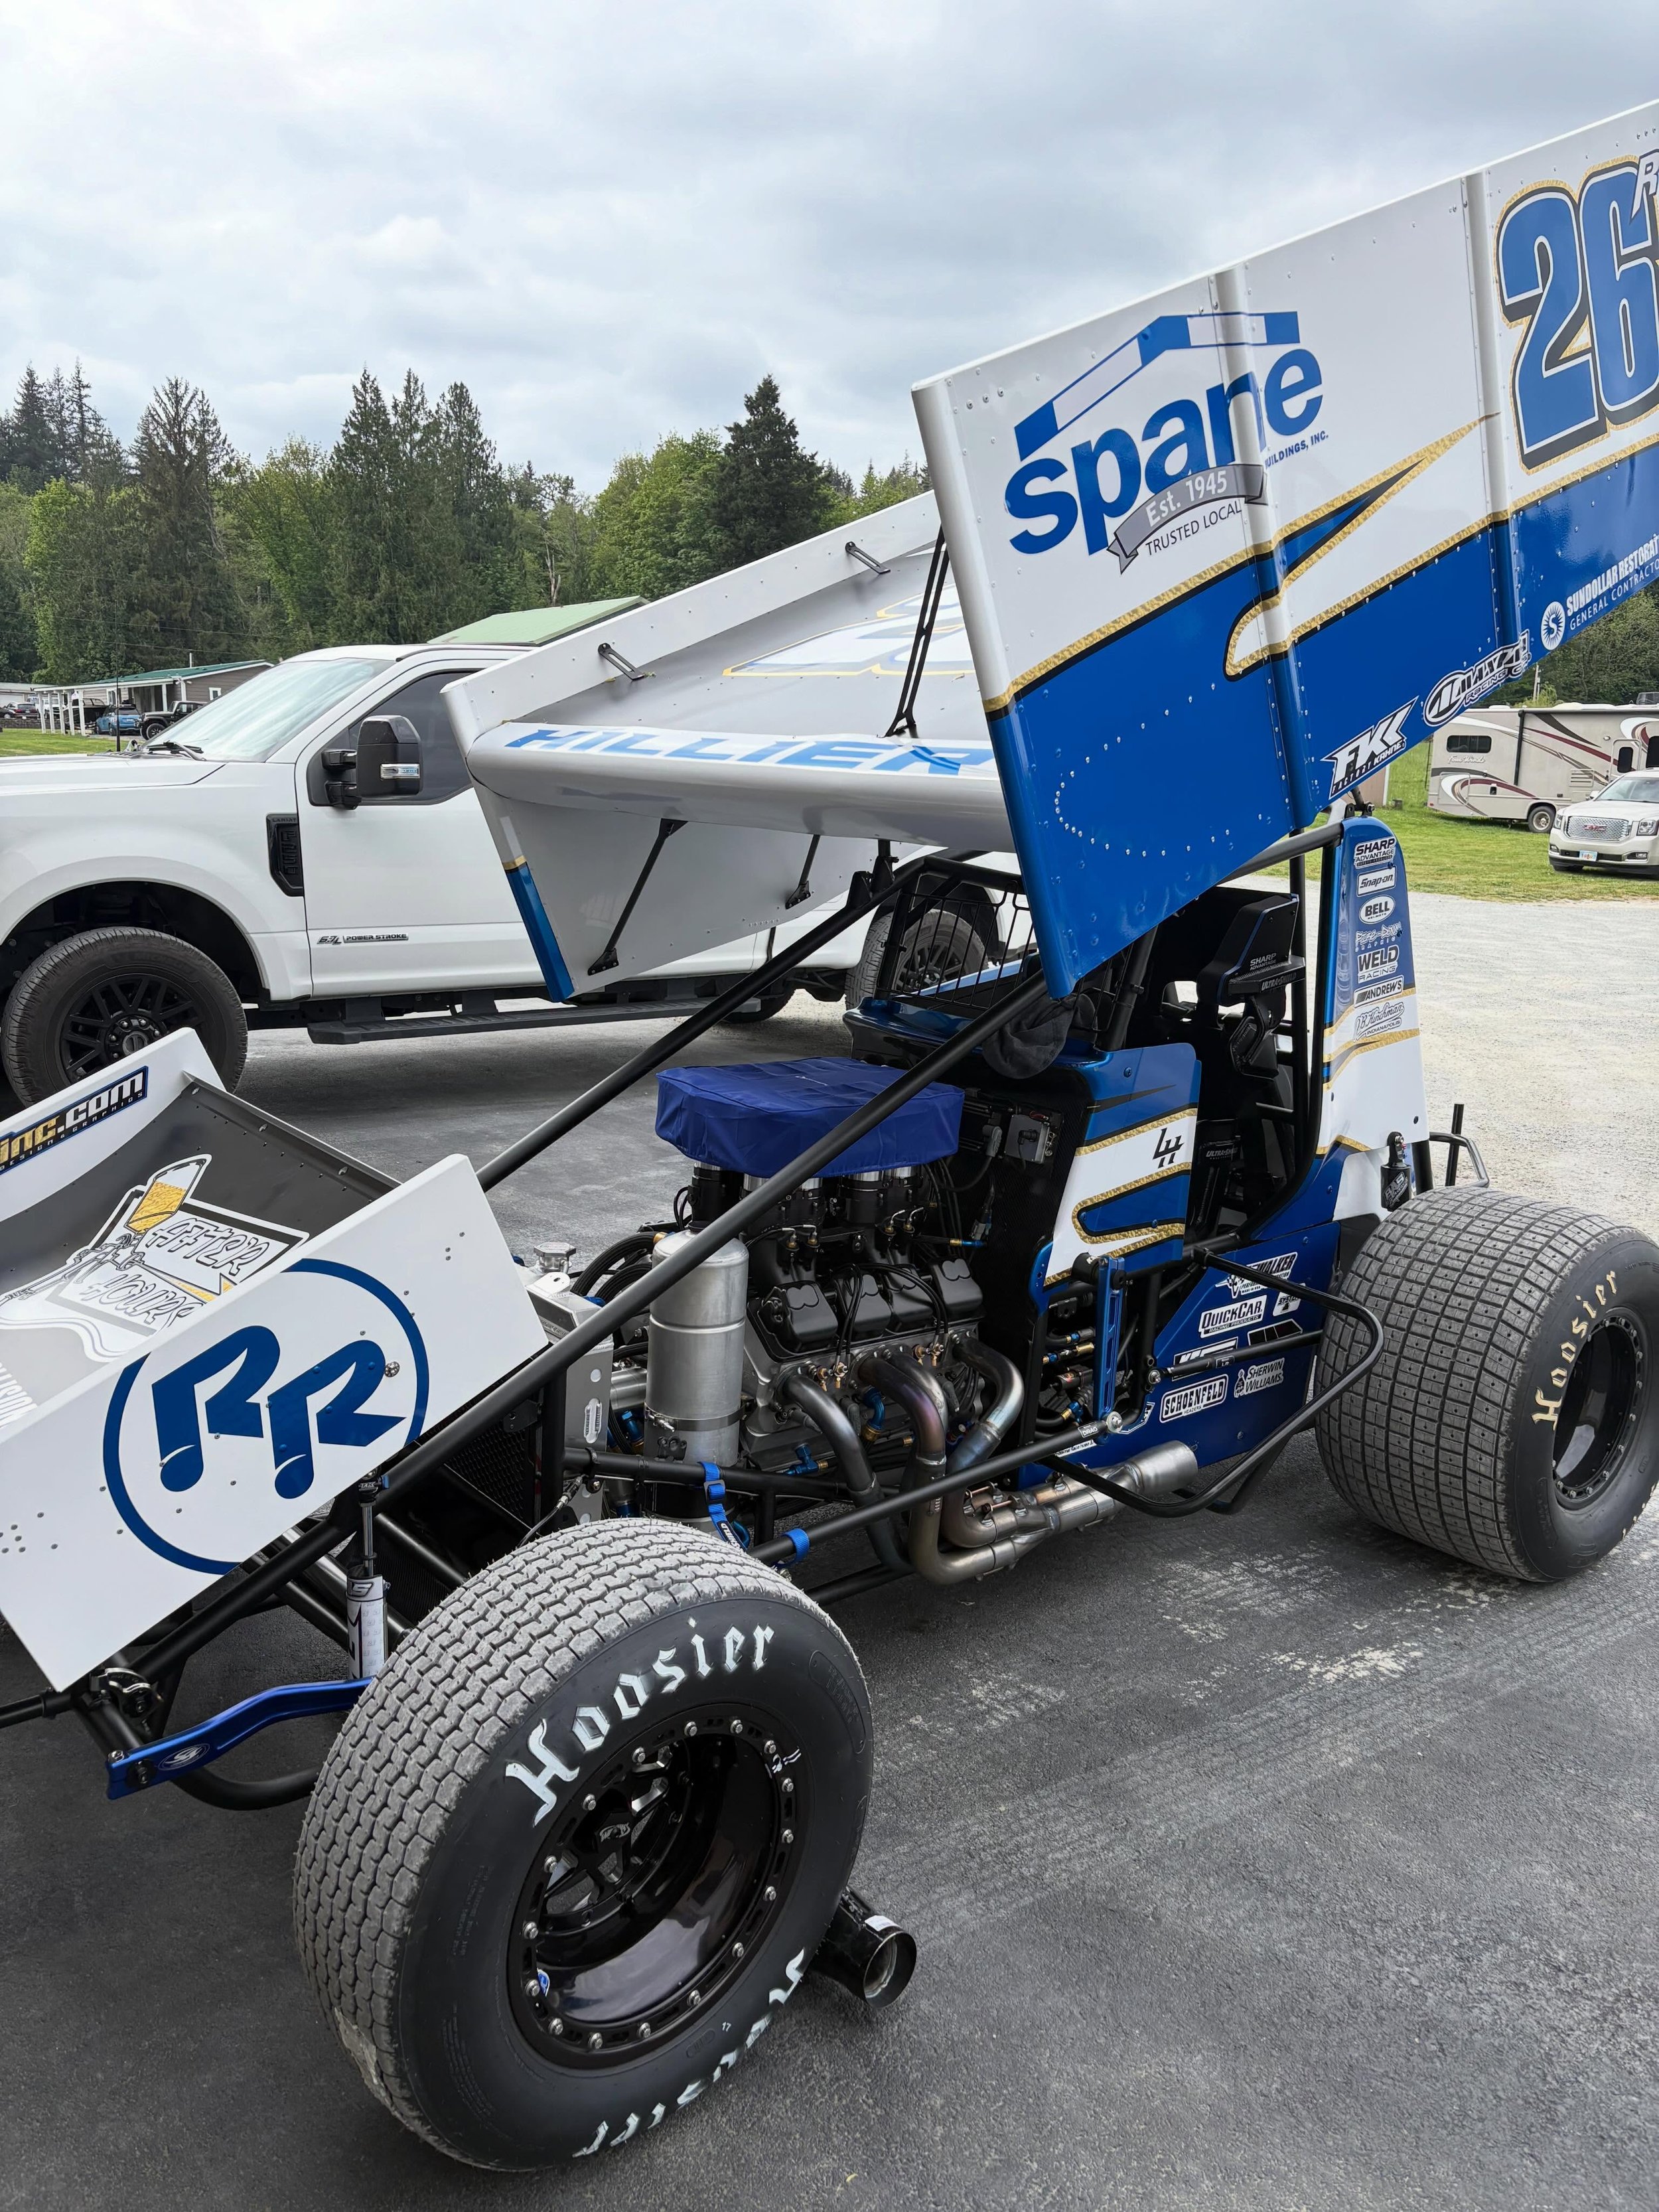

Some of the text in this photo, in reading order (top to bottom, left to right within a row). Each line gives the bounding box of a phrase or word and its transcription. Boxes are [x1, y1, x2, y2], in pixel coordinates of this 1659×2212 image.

[1311, 430, 1329, 446] INC.
[1145, 470, 1227, 528] Est. 1945
[1145, 499, 1242, 556] TRUSTED LOCAL
[1566, 565, 1618, 617] SUNDOLLAR
[1569, 596, 1609, 630] GENERAL
[504, 729, 995, 776] HILLIER
[1373, 741, 1402, 766] KAHNE
[1355, 849, 1395, 863] ADVANTAGE
[1356, 838, 1396, 856] SHARP
[1360, 874, 1394, 889] Snap-on
[1364, 901, 1390, 917] BELL
[1250, 952, 1277, 966] SHARP
[1358, 946, 1399, 972] WELD
[1358, 964, 1396, 981] RACING
[1365, 980, 1402, 1001] ANDREWS
[1366, 1019, 1400, 1035] INDIANAPOLIS
[72, 1092, 143, 1132] GRAPHICS
[146, 1217, 270, 1276] AFTER
[1208, 1315, 1260, 1333] RACING PRODUCTS
[1531, 1270, 1618, 1432] Hoosier
[1248, 1361, 1283, 1380] SHERWIN
[1164, 1382, 1224, 1416] SCHOENFELD
[1183, 1405, 1202, 1415] HEADERS
[1082, 1426, 1098, 1436] DRAG
[505, 1616, 775, 1827] Hoosier
